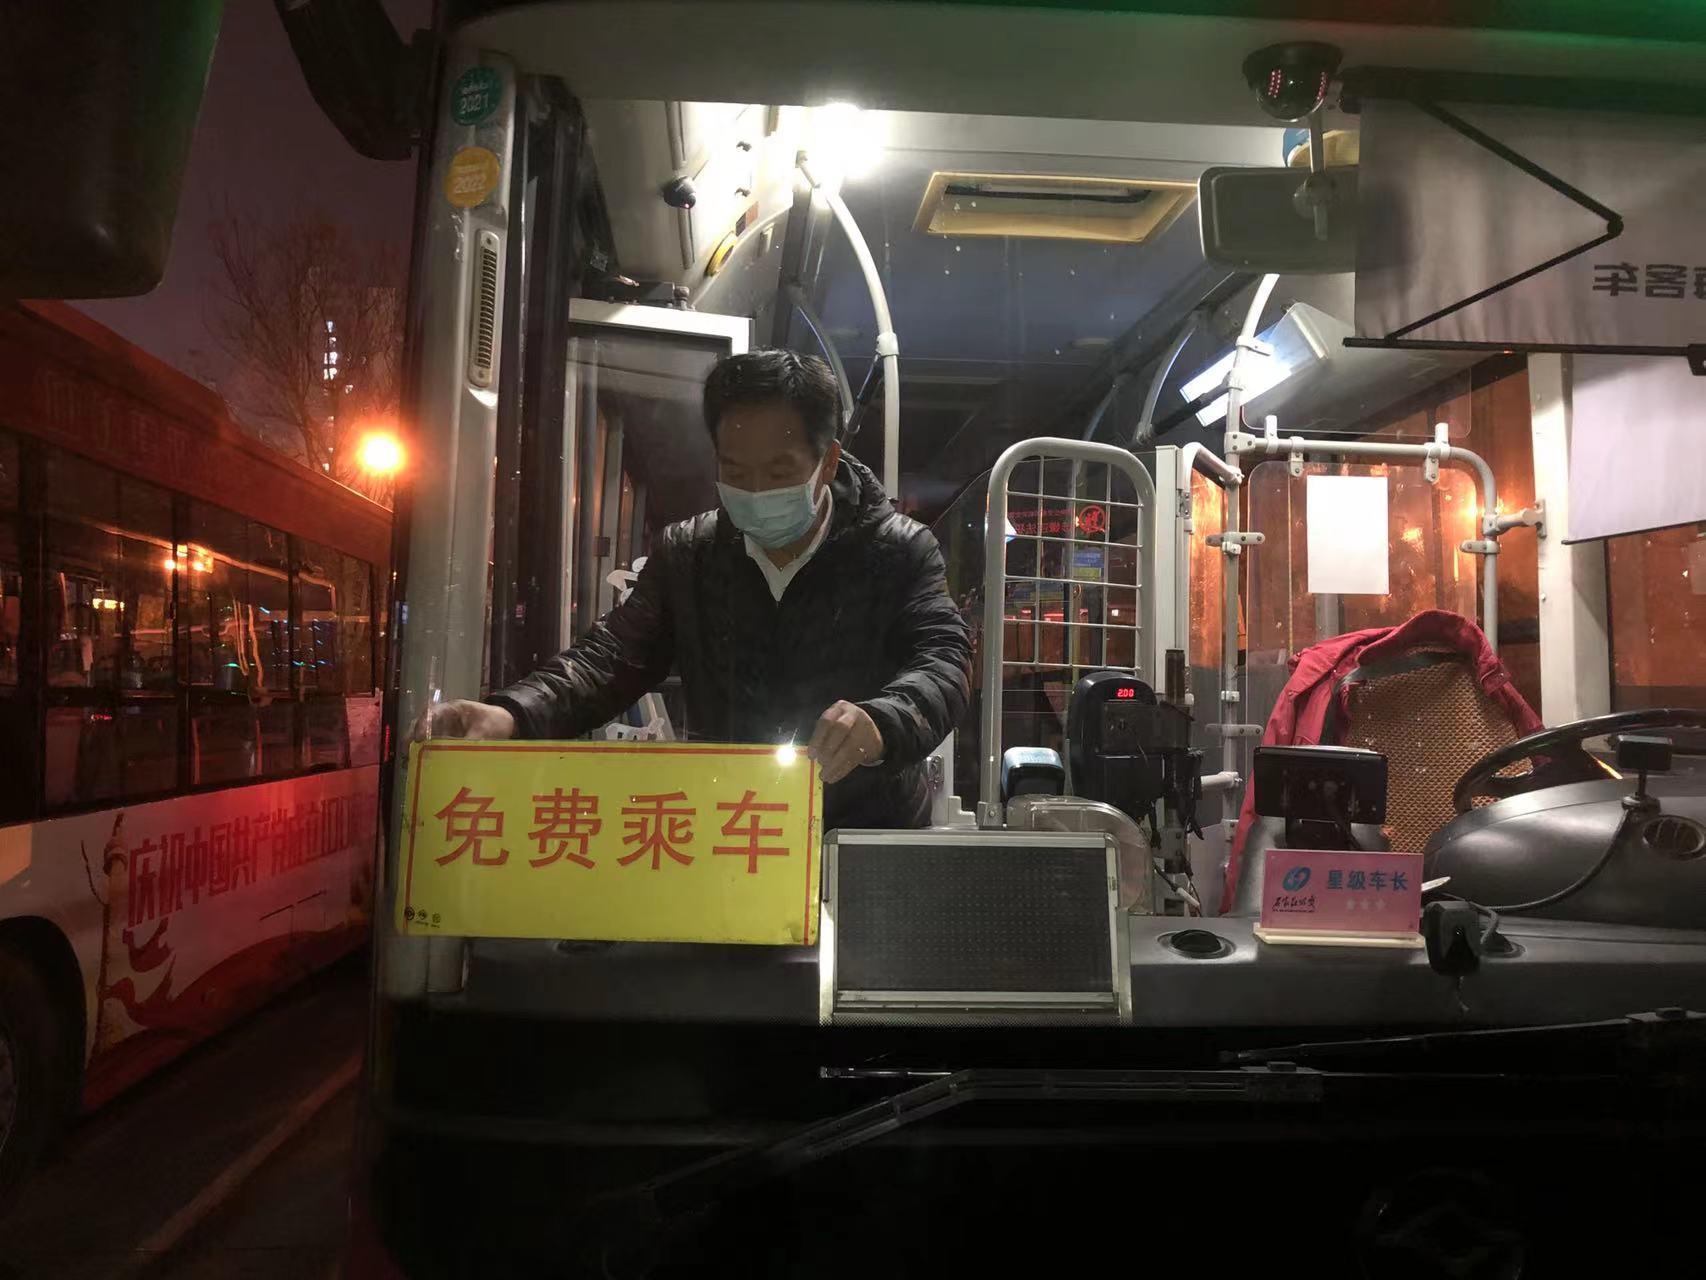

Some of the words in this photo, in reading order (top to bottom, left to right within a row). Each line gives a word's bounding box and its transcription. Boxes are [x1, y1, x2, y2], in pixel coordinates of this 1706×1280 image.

[434, 786, 790, 874] 免费乘车
[1327, 869, 1408, 891] 星级车长
